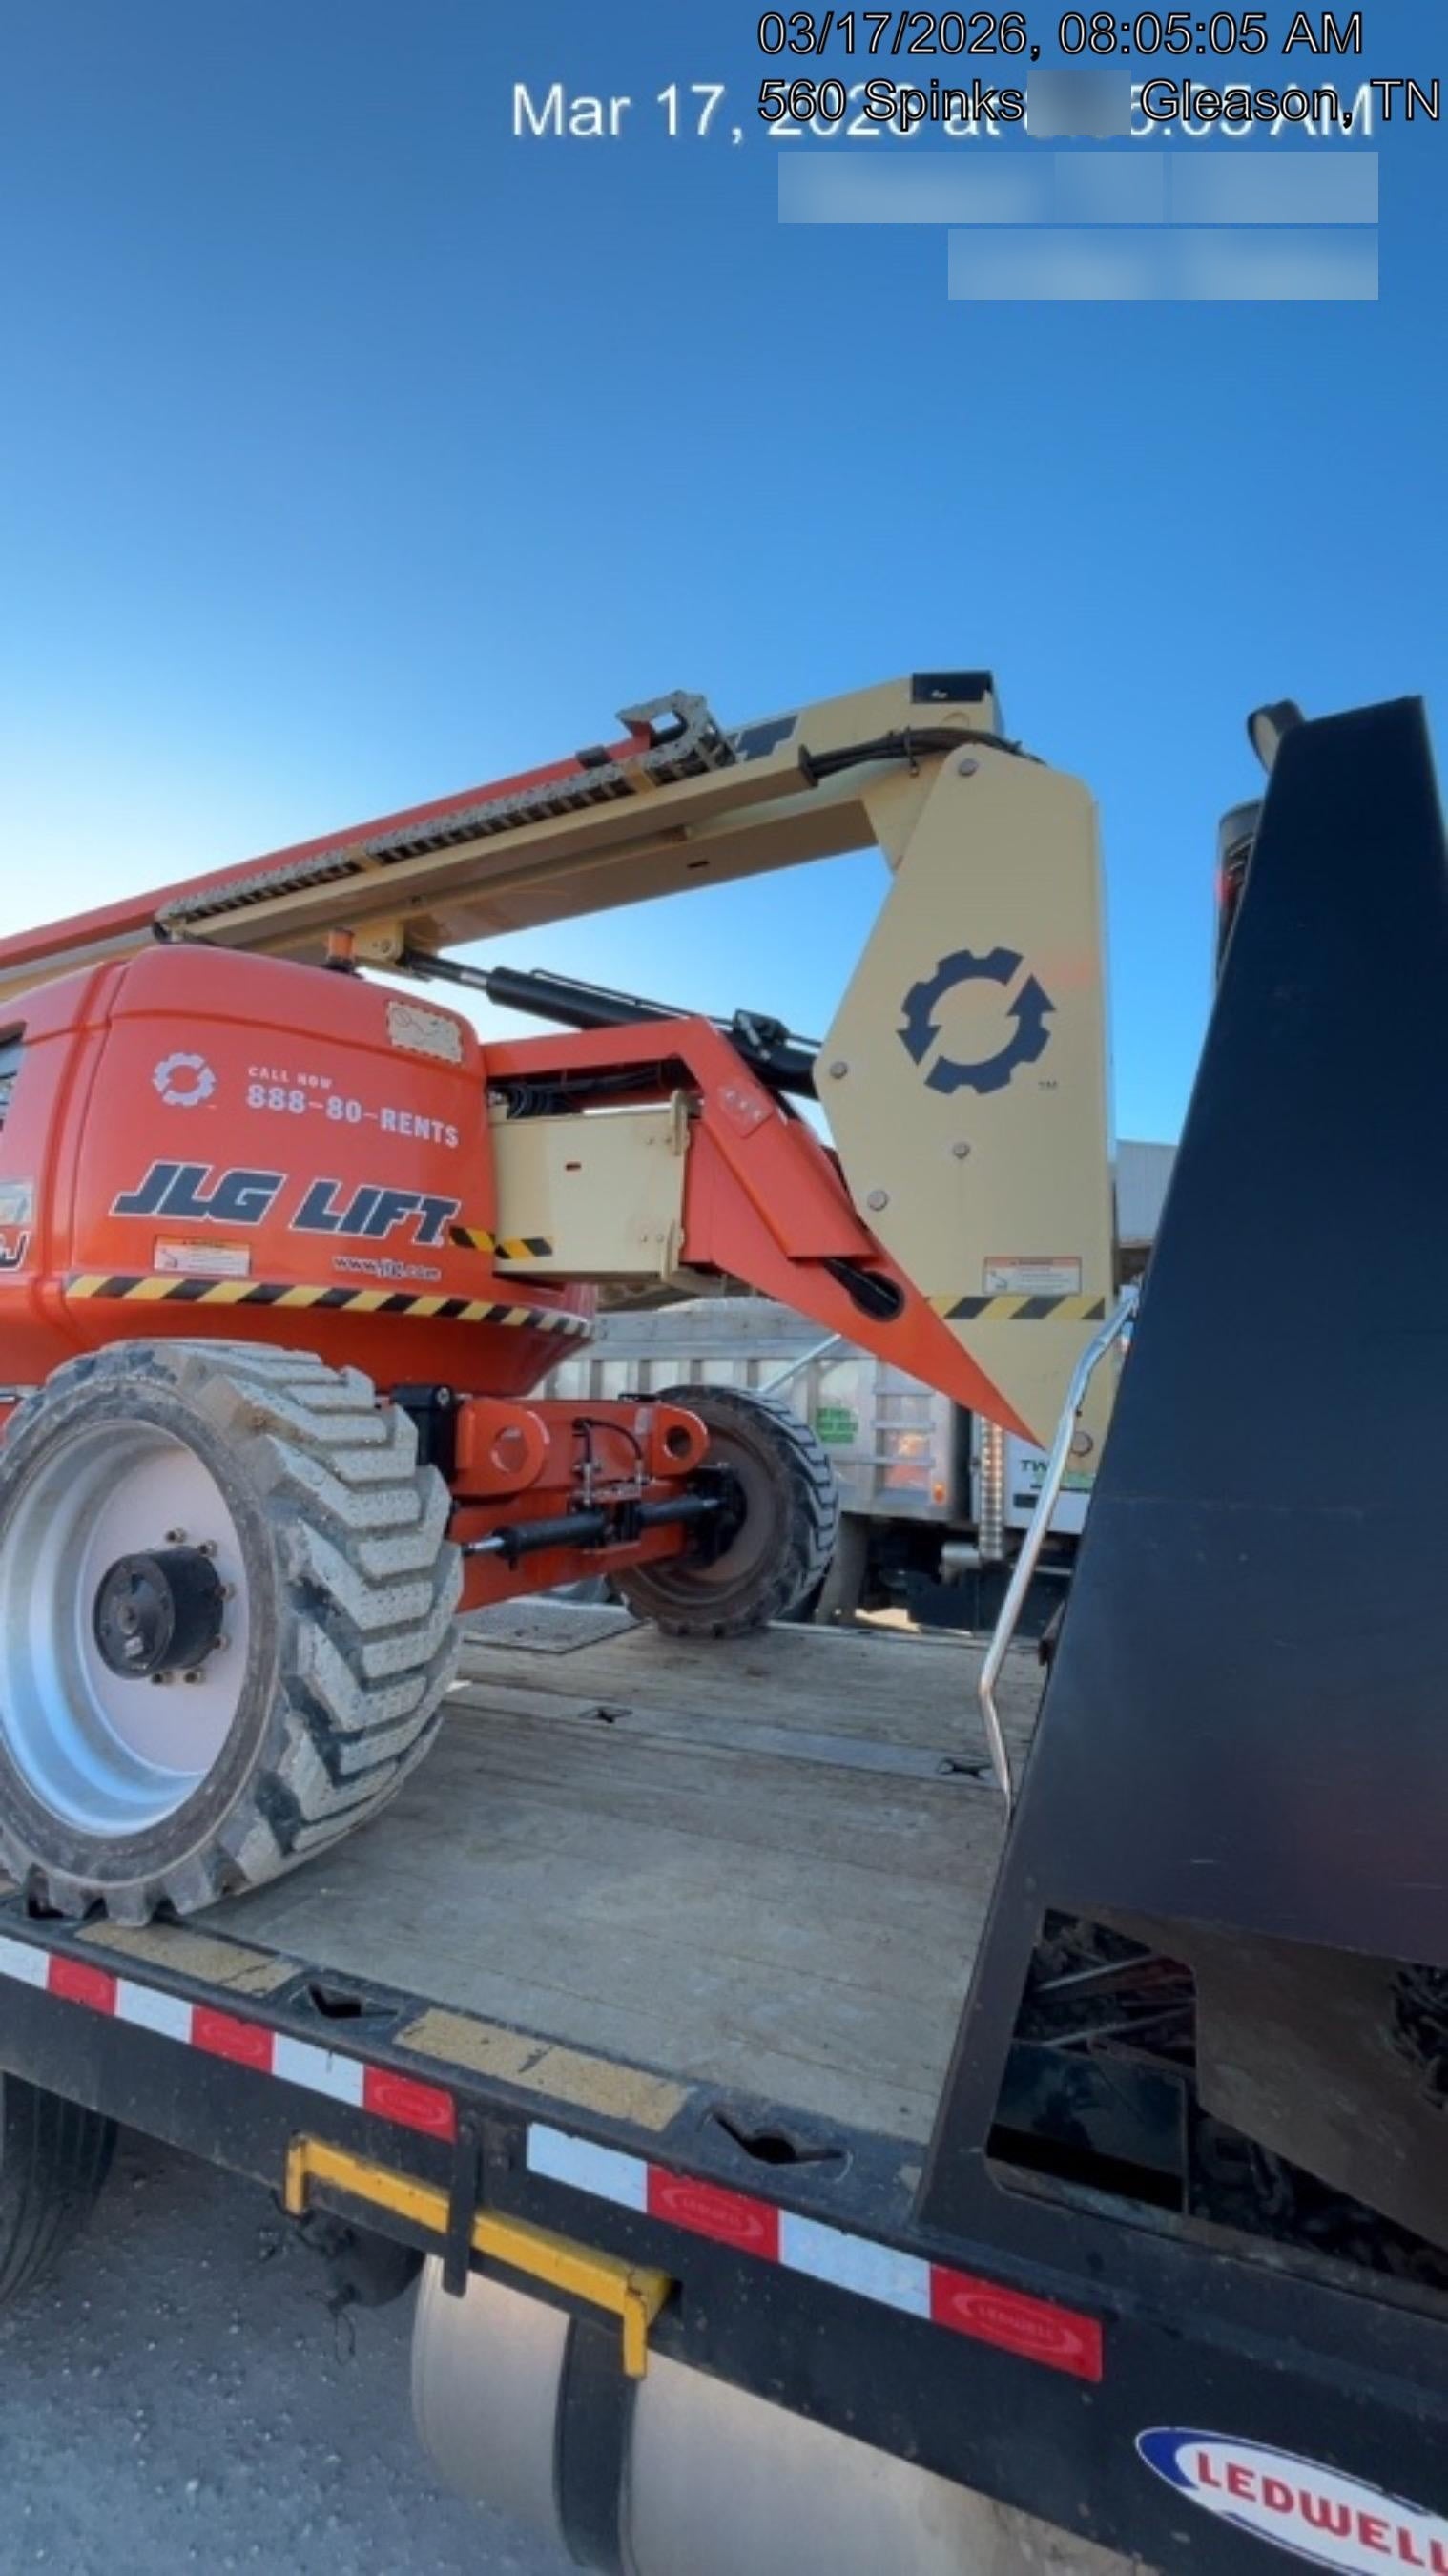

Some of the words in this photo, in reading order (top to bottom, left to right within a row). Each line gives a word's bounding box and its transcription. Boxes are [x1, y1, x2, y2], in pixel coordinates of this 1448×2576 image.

[246, 1083, 460, 1149] 888-80-RENTS
[248, 1066, 290, 1083] CALL
[297, 1072, 333, 1090] NOW
[108, 1159, 288, 1226] JLG
[289, 1177, 462, 1247] LIFT
[1196, 2450, 1448, 2576] LEDWELL
